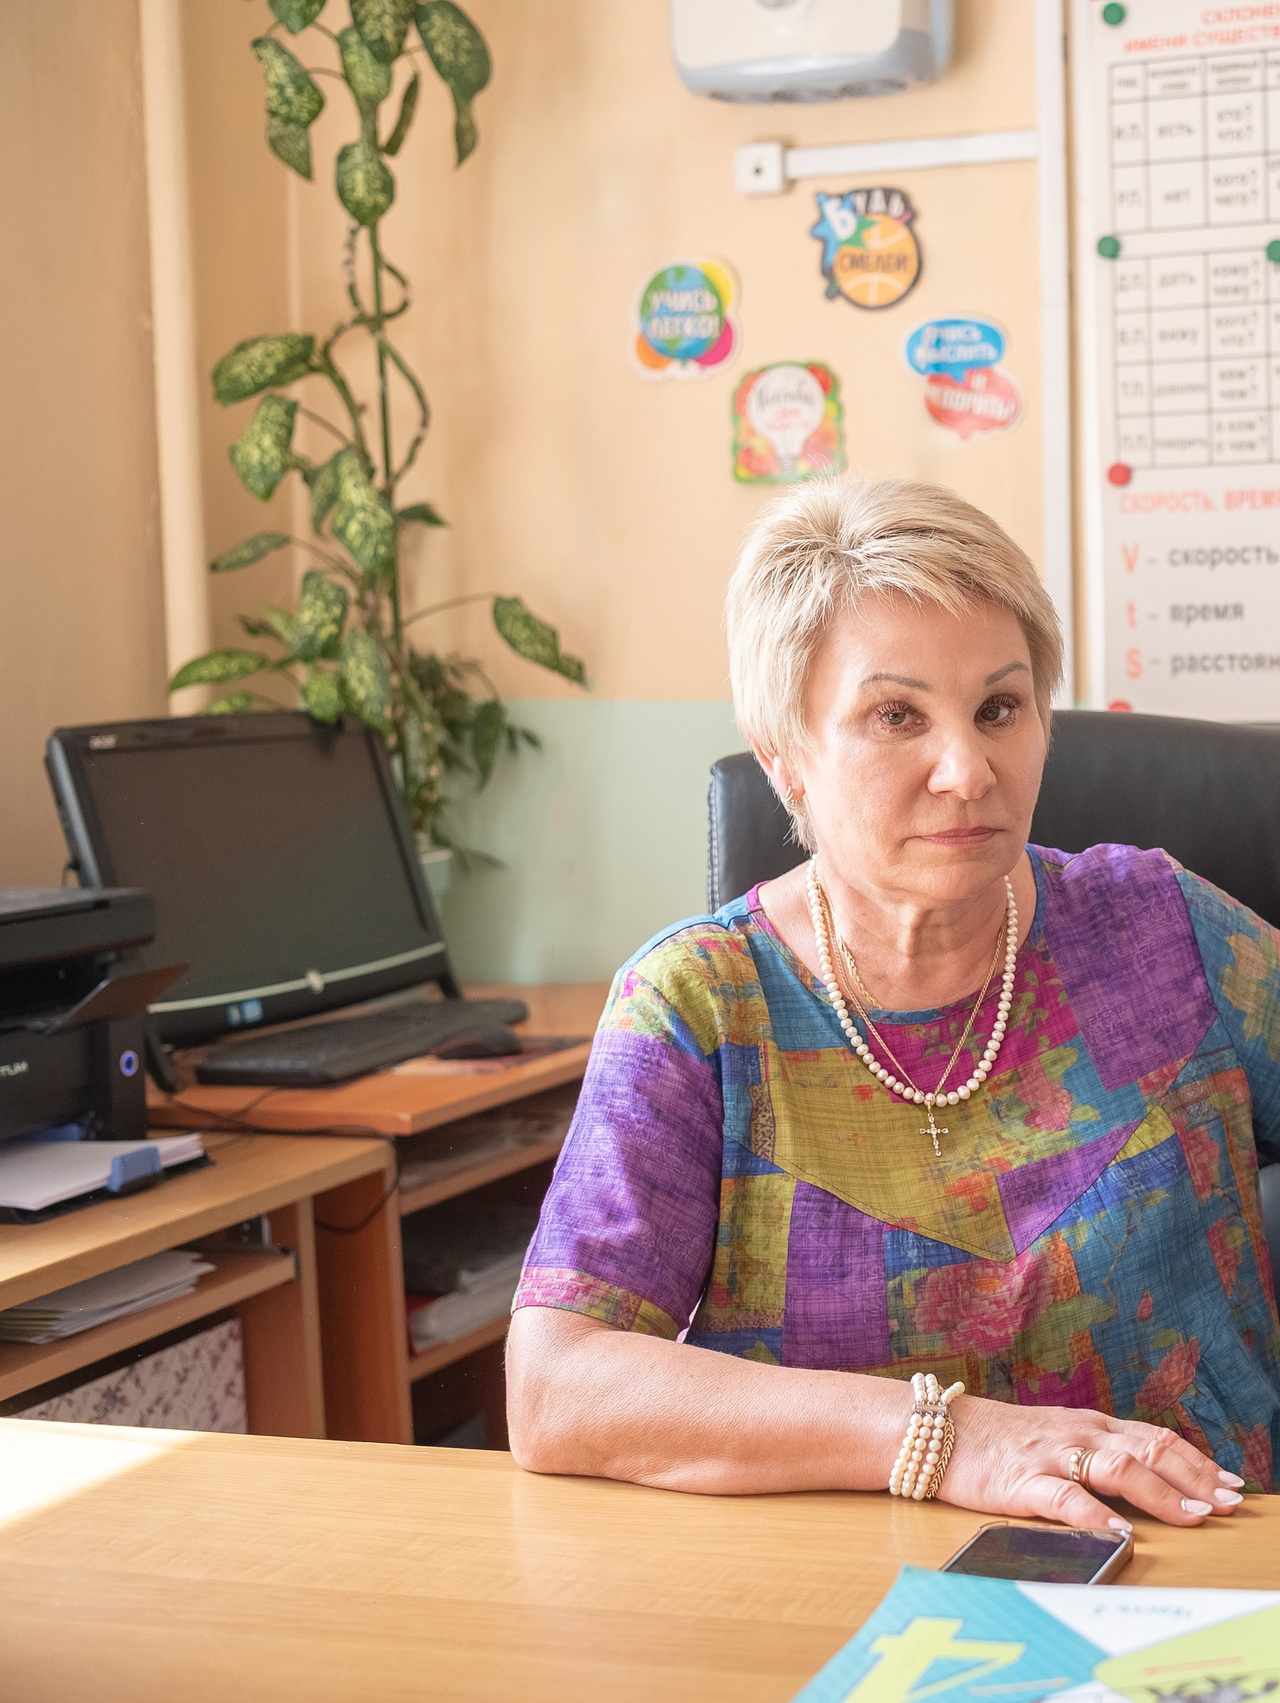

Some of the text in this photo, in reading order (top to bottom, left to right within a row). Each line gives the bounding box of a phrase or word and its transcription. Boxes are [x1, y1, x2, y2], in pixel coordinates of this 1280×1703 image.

[1124, 35, 1187, 53] ИМЕНИ
[1121, 543, 1140, 575] V
[1167, 545, 1280, 571] скорость
[1126, 601, 1137, 629] t
[1169, 600, 1246, 628] время
[1125, 648, 1143, 680] S
